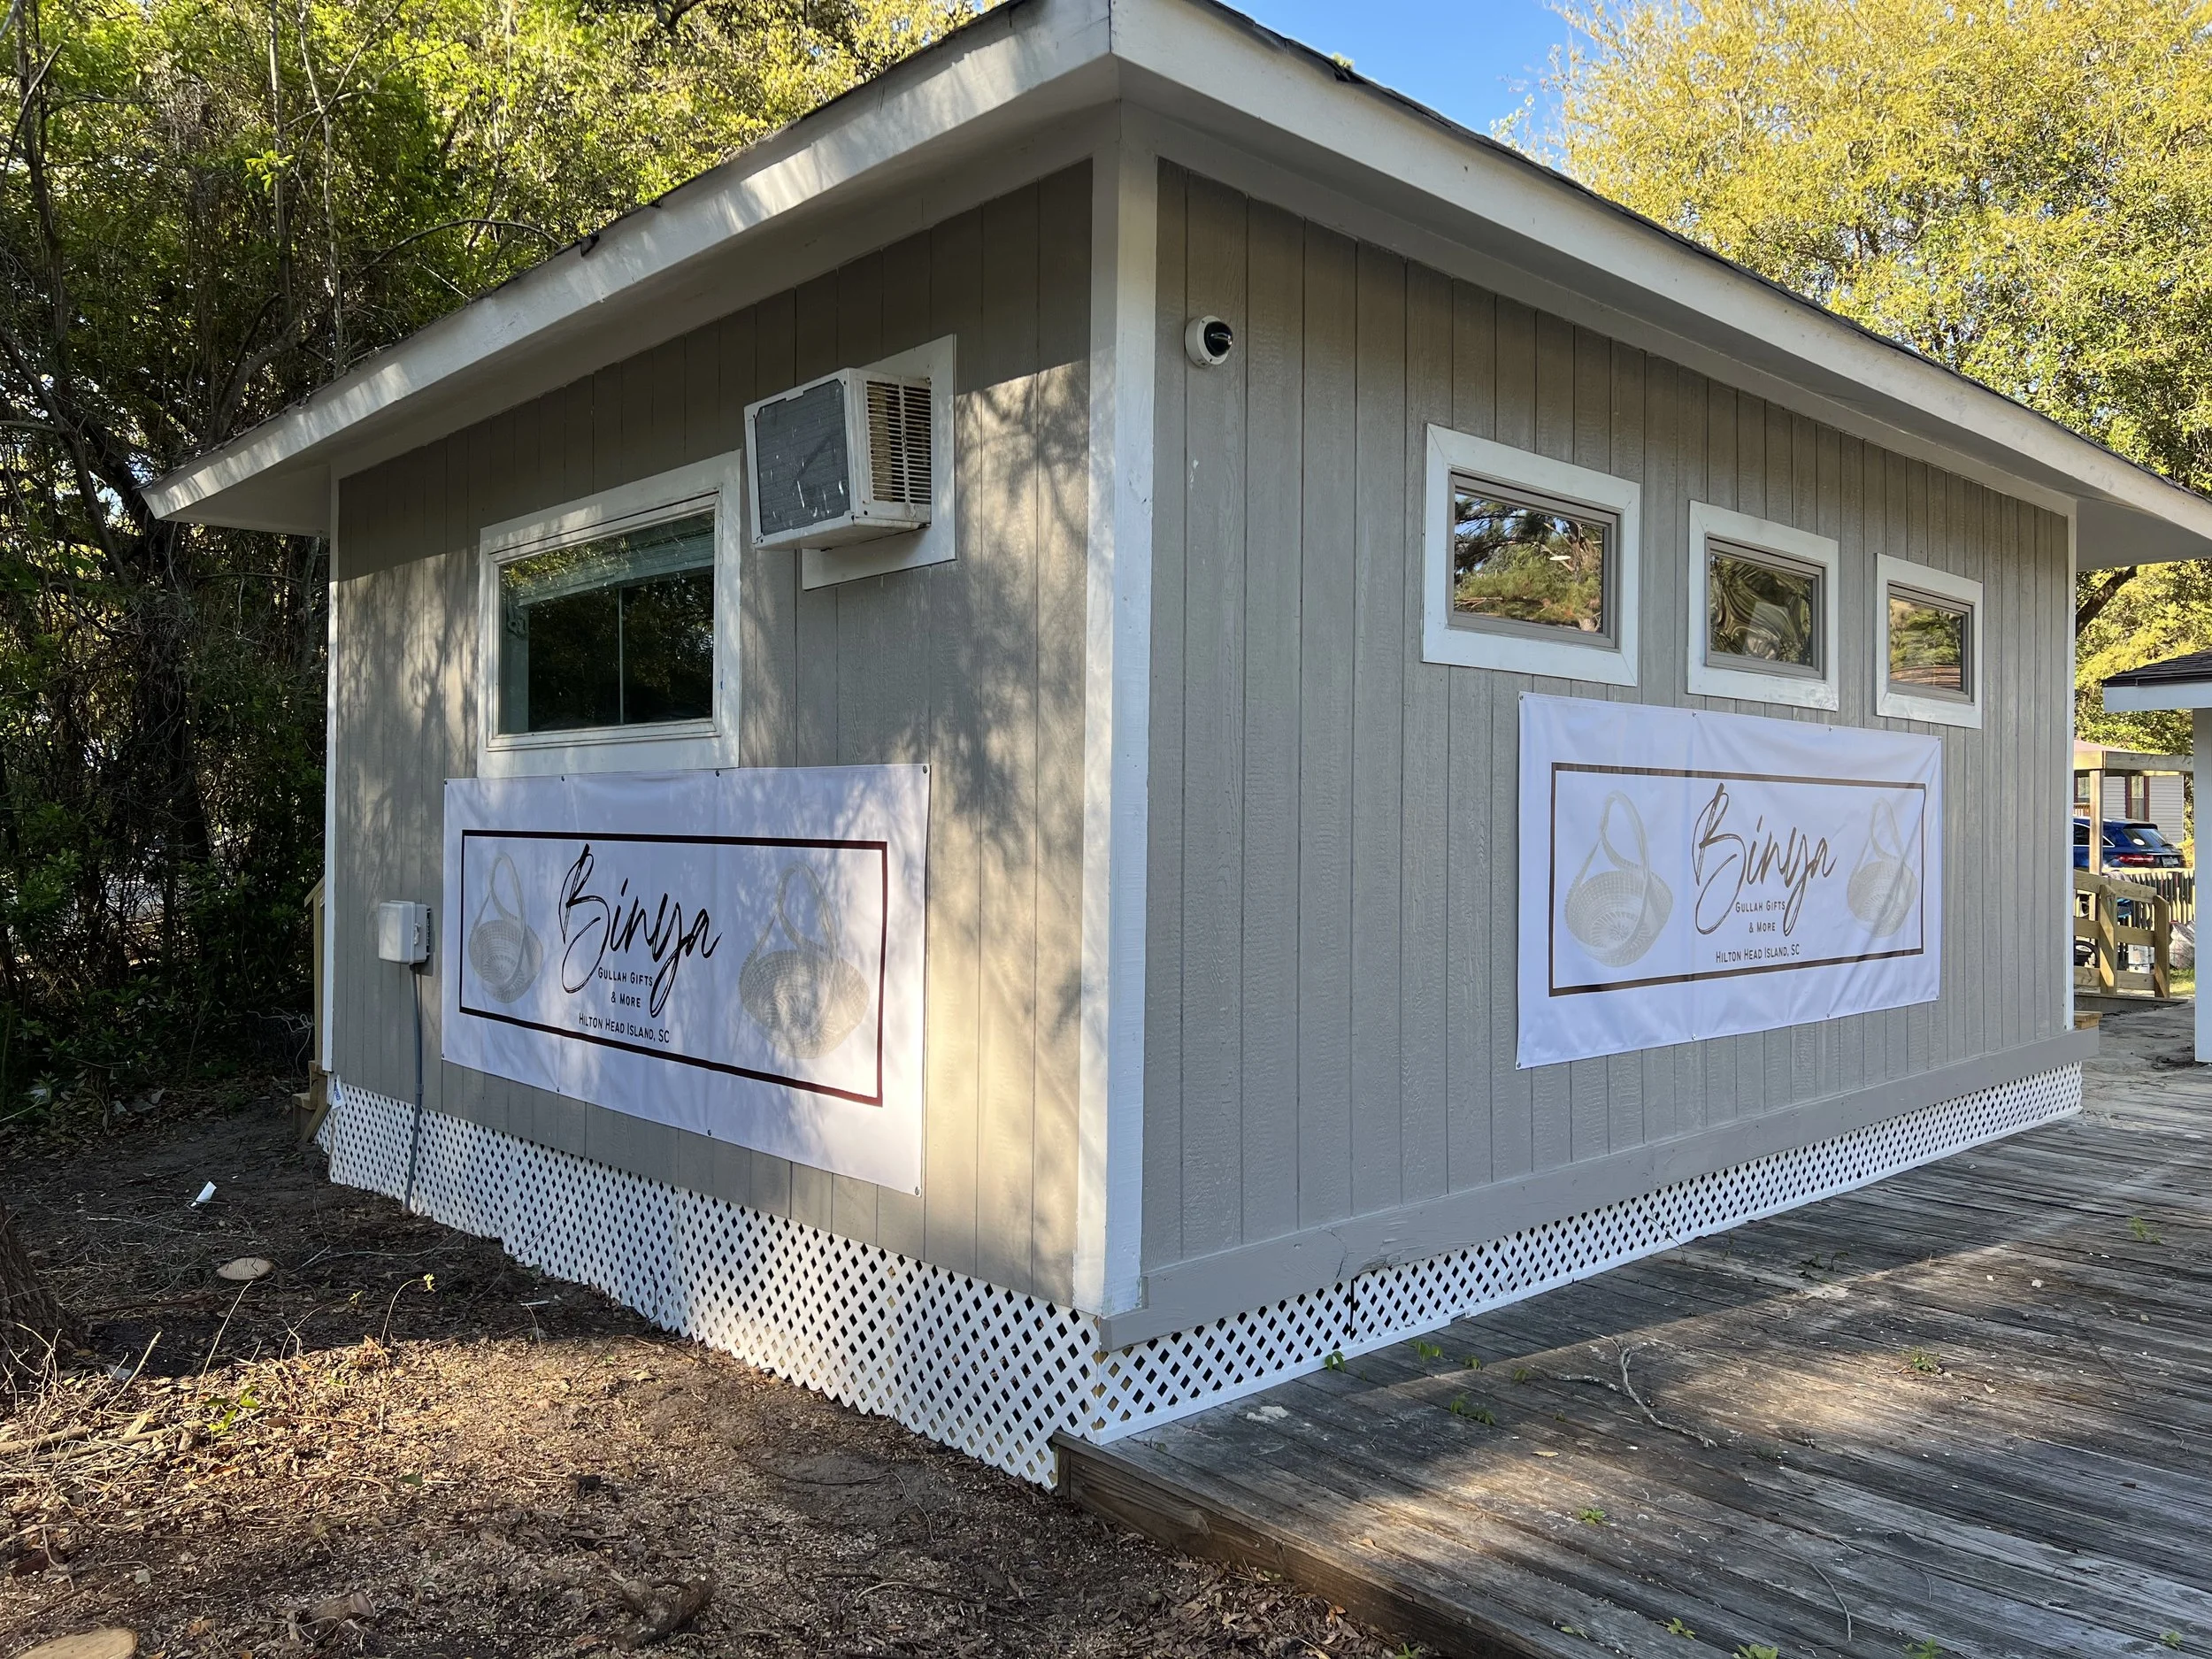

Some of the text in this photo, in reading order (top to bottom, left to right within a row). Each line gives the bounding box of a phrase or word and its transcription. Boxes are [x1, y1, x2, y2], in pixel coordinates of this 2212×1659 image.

[1692, 783, 1838, 937] Binya
[558, 843, 723, 1018] Binya
[1748, 922, 1754, 933] &
[1791, 944, 1800, 955] SC
[611, 991, 617, 1003] &
[658, 1030, 670, 1043] SC
